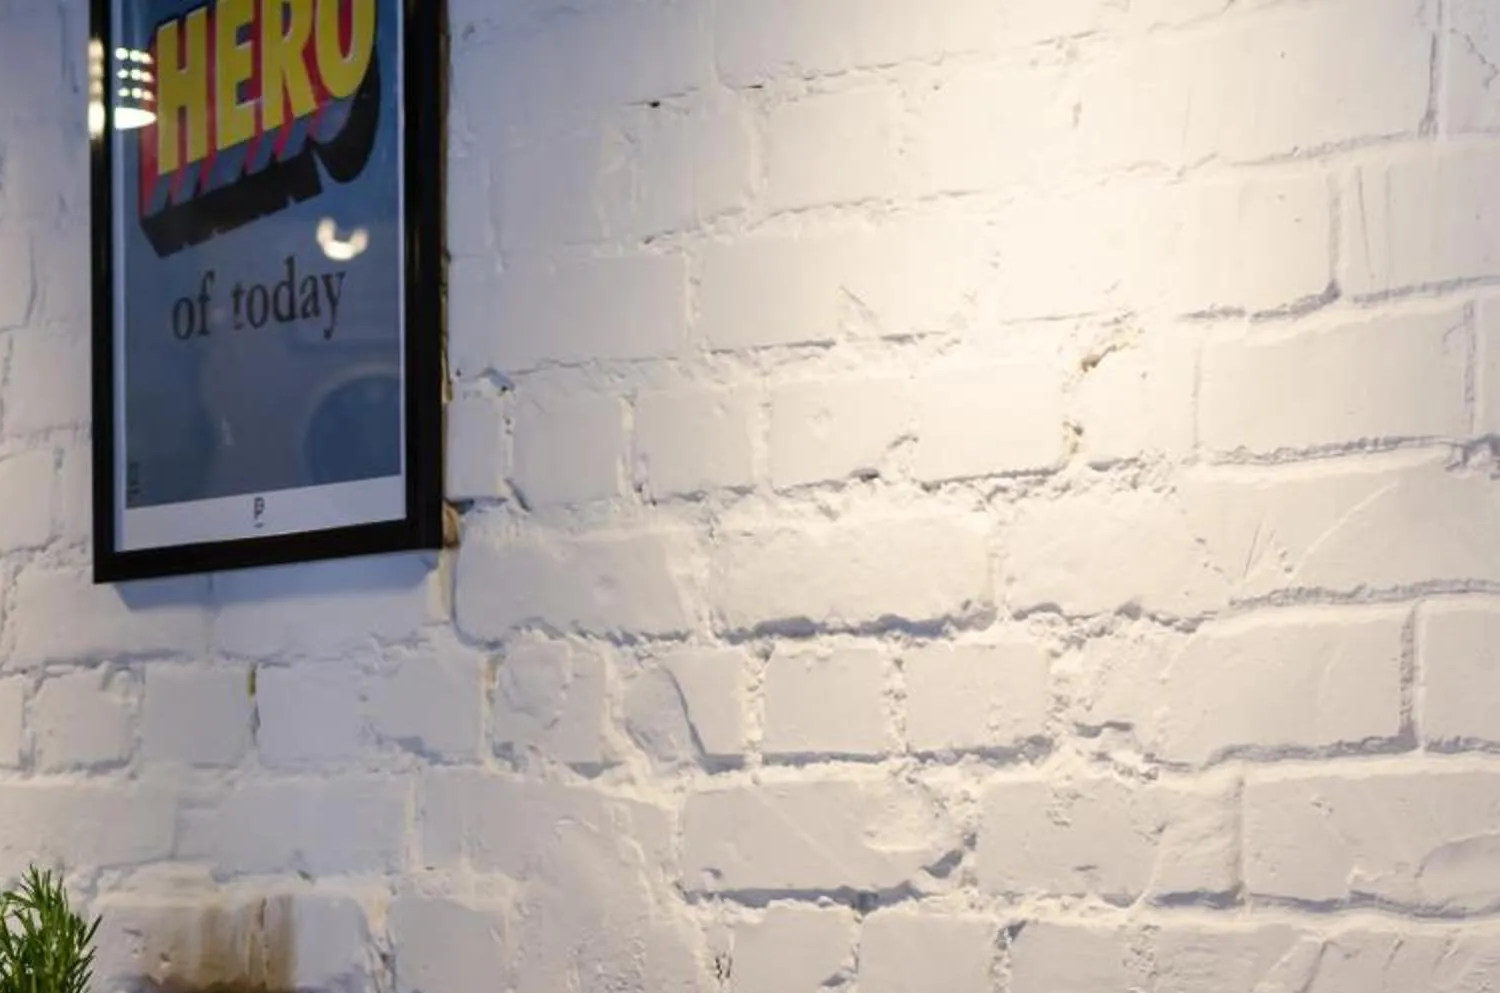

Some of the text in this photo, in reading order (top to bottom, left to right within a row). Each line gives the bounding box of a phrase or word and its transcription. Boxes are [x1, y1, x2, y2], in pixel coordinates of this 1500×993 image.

[155, 0, 377, 178] HERO
[171, 255, 346, 340] of today
